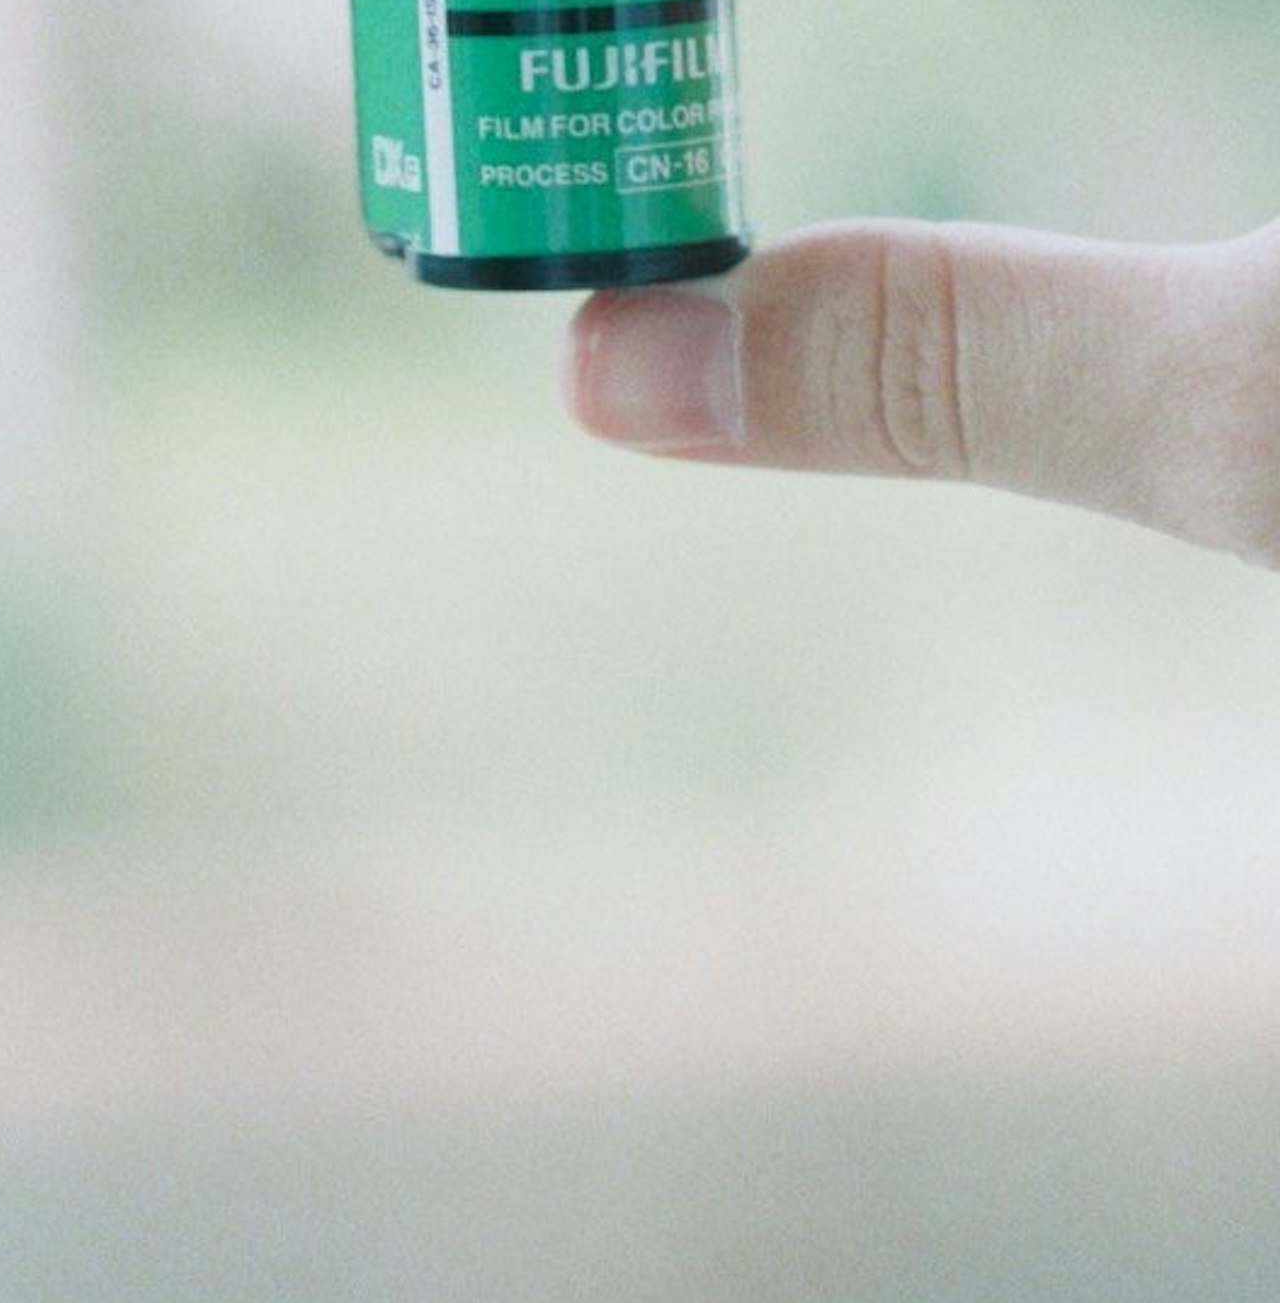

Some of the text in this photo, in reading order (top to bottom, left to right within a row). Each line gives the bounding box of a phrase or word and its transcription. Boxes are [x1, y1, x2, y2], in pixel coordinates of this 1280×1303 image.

[478, 117, 545, 139] FILM
[552, 114, 612, 137] FOR
[617, 102, 705, 134] COLOR
[481, 147, 710, 186] PROCESS CN-16
